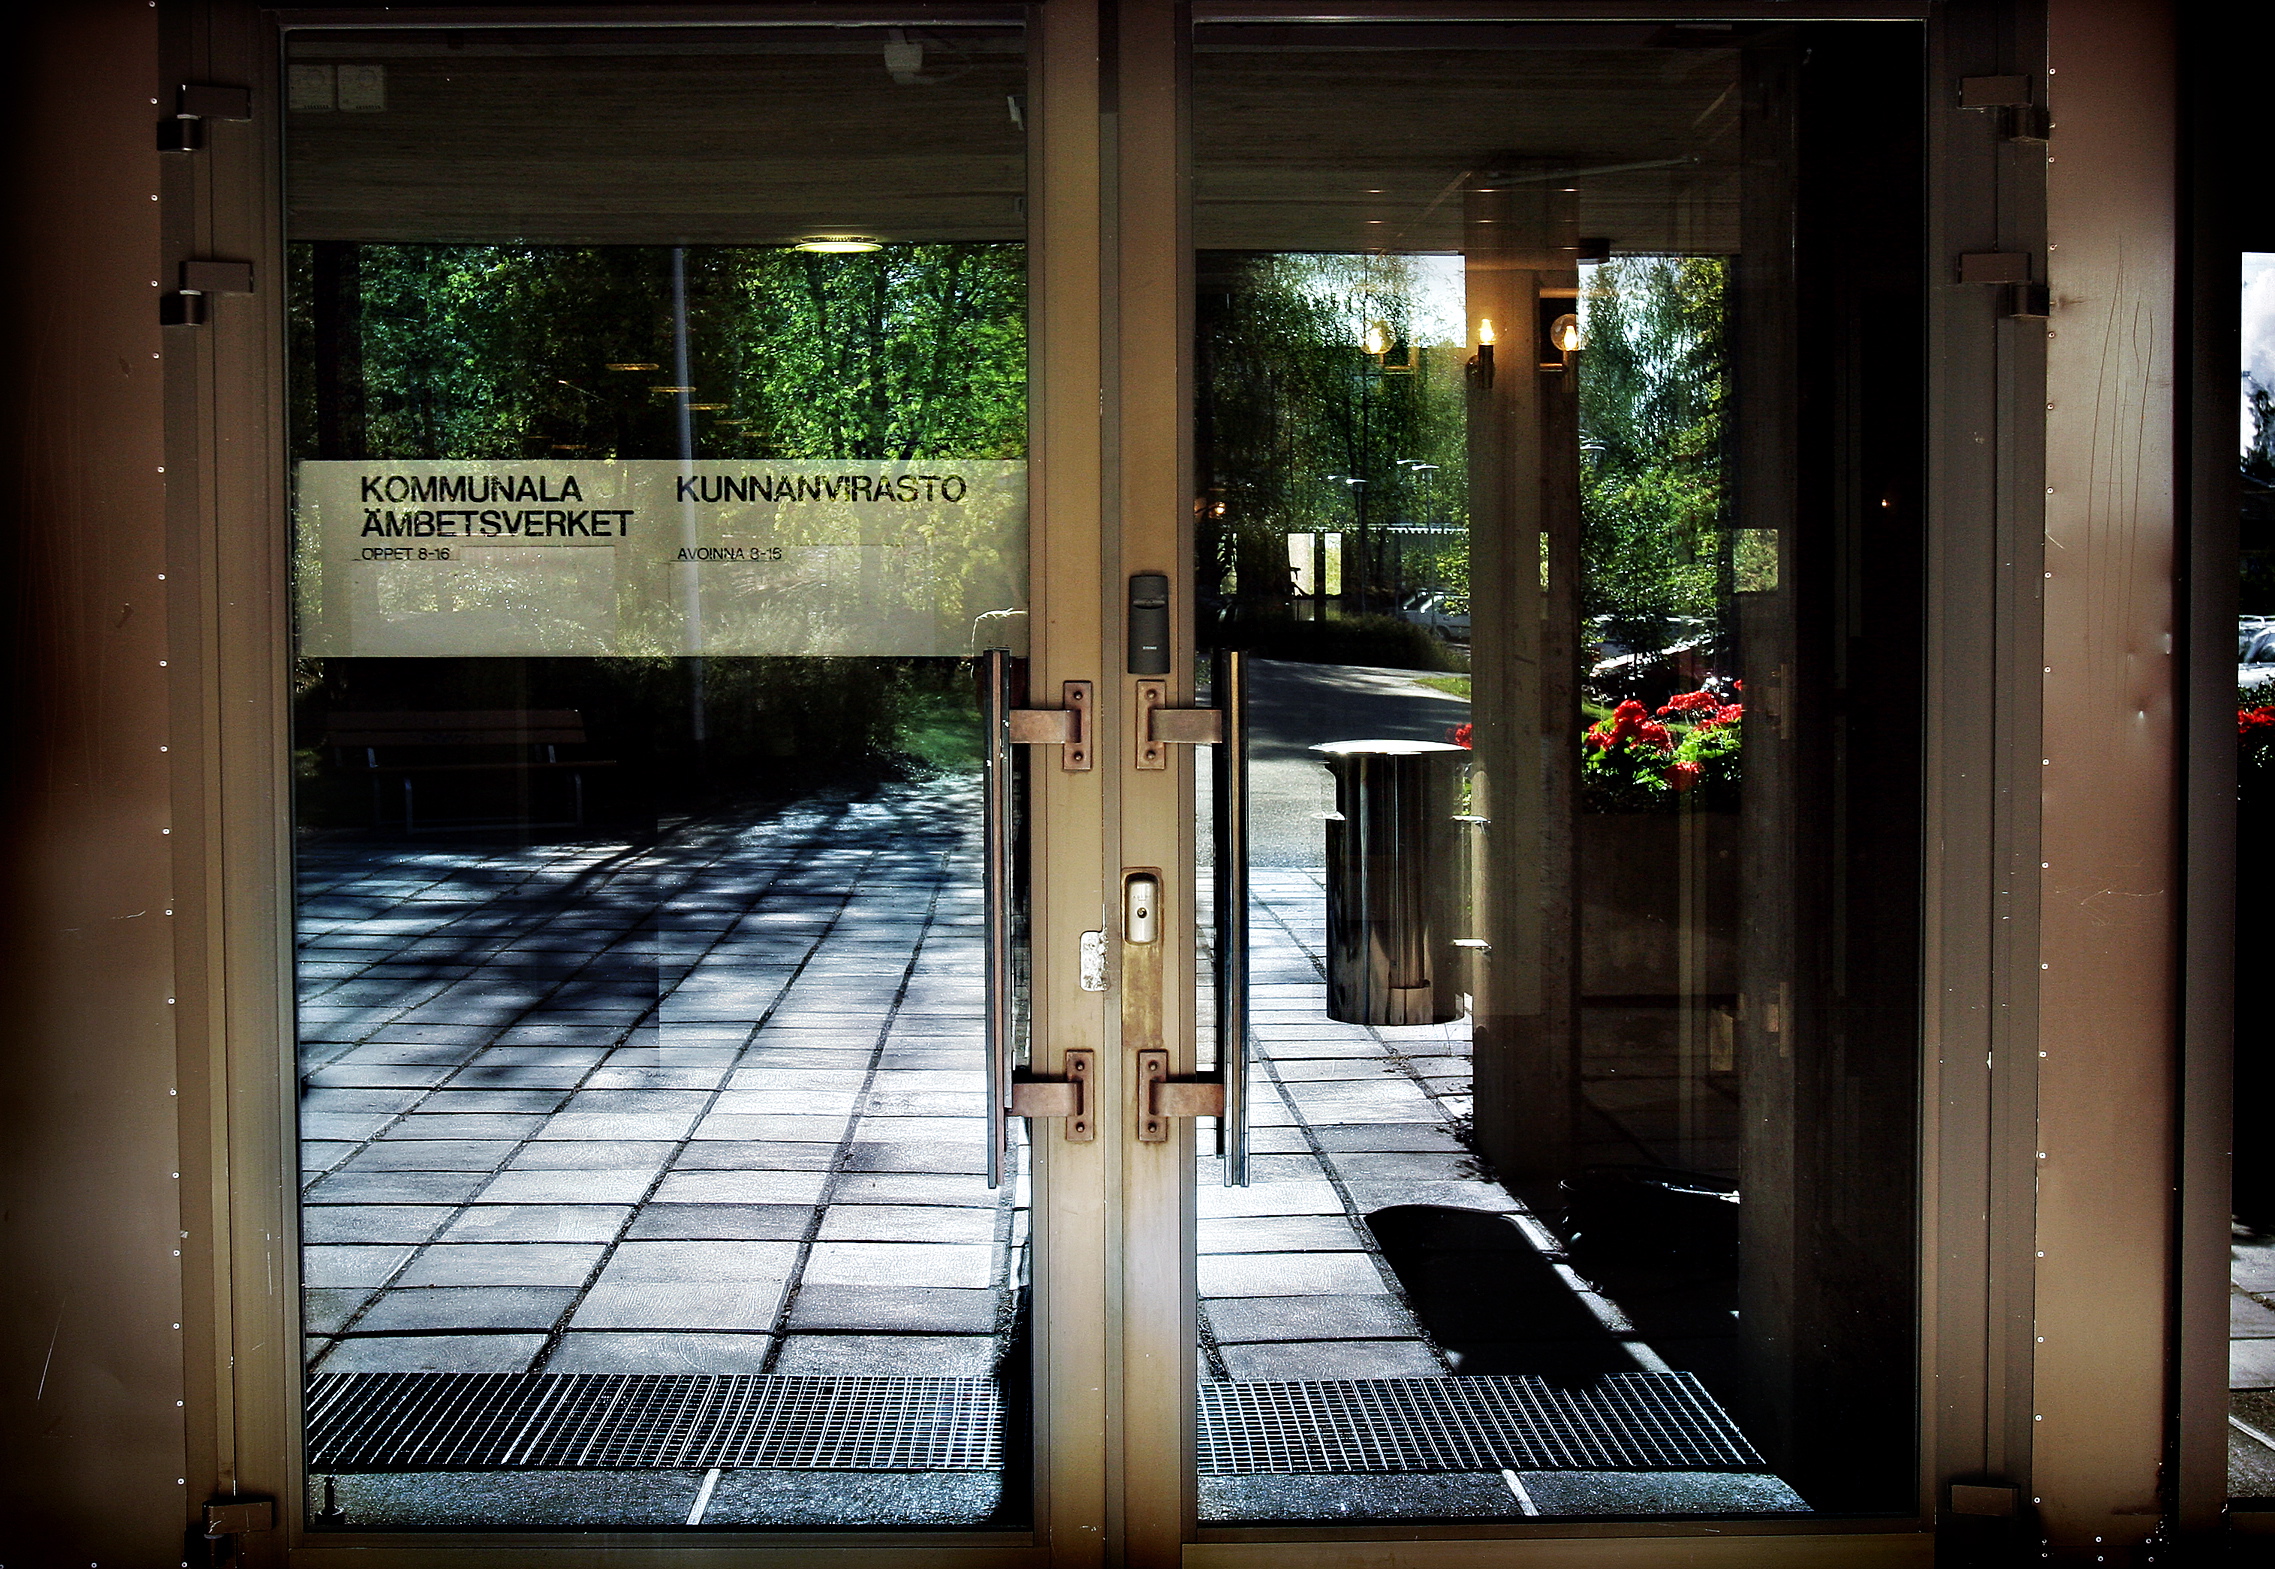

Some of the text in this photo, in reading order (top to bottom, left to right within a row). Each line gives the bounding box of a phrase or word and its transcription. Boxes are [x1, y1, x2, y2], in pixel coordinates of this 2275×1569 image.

[361, 476, 583, 502] KOMMUNALA
[677, 475, 966, 502] KUNNANVIRASTO
[361, 507, 634, 537] ÄMBETSVERKET
[419, 548, 450, 560] 8-16
[678, 547, 745, 560] AVOINNA
